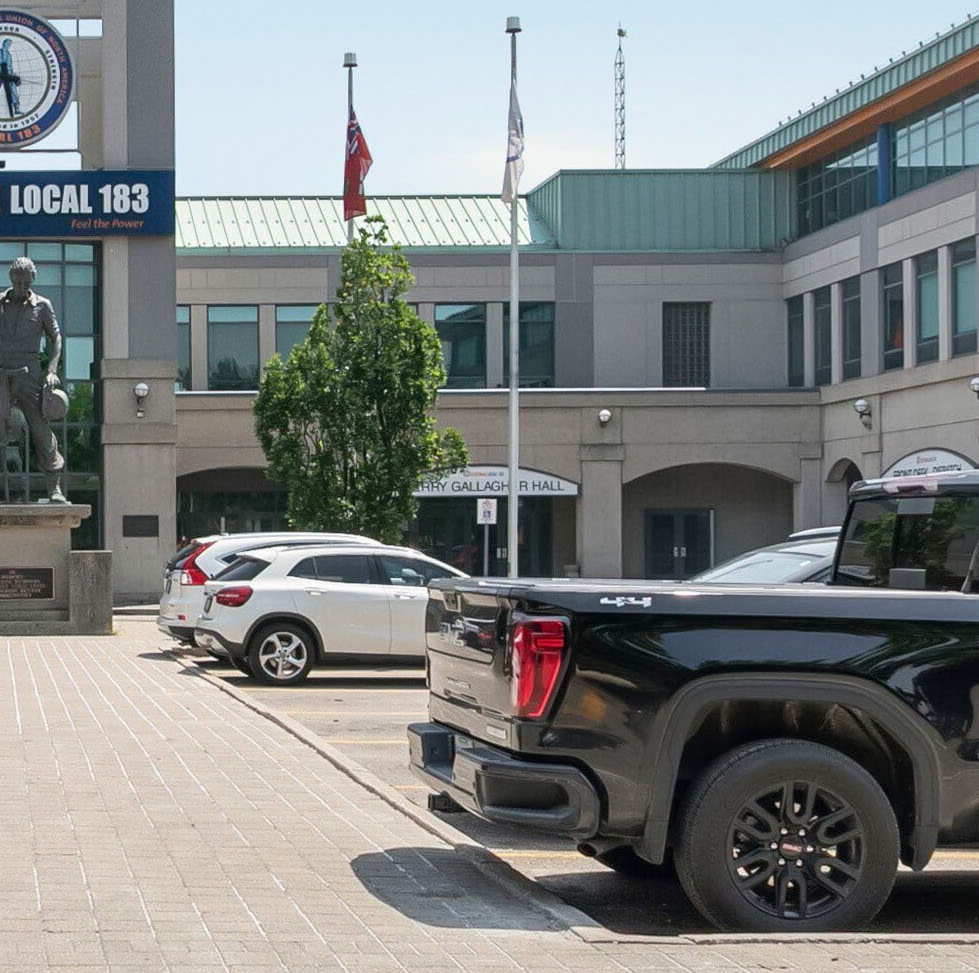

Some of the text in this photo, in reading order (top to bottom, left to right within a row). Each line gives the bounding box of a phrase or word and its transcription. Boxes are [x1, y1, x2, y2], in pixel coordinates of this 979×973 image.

[6, 15, 33, 28] UNION
[37, 25, 46, 35] OF
[48, 35, 66, 62] NORTH
[56, 67, 69, 104] AMERICA
[17, 124, 41, 140] 183
[10, 184, 93, 214] LOCAL
[98, 183, 150, 214] 183
[71, 217, 144, 229] Feel the Power
[451, 481, 529, 492] GALLAGHR
[532, 480, 564, 491] HALL
